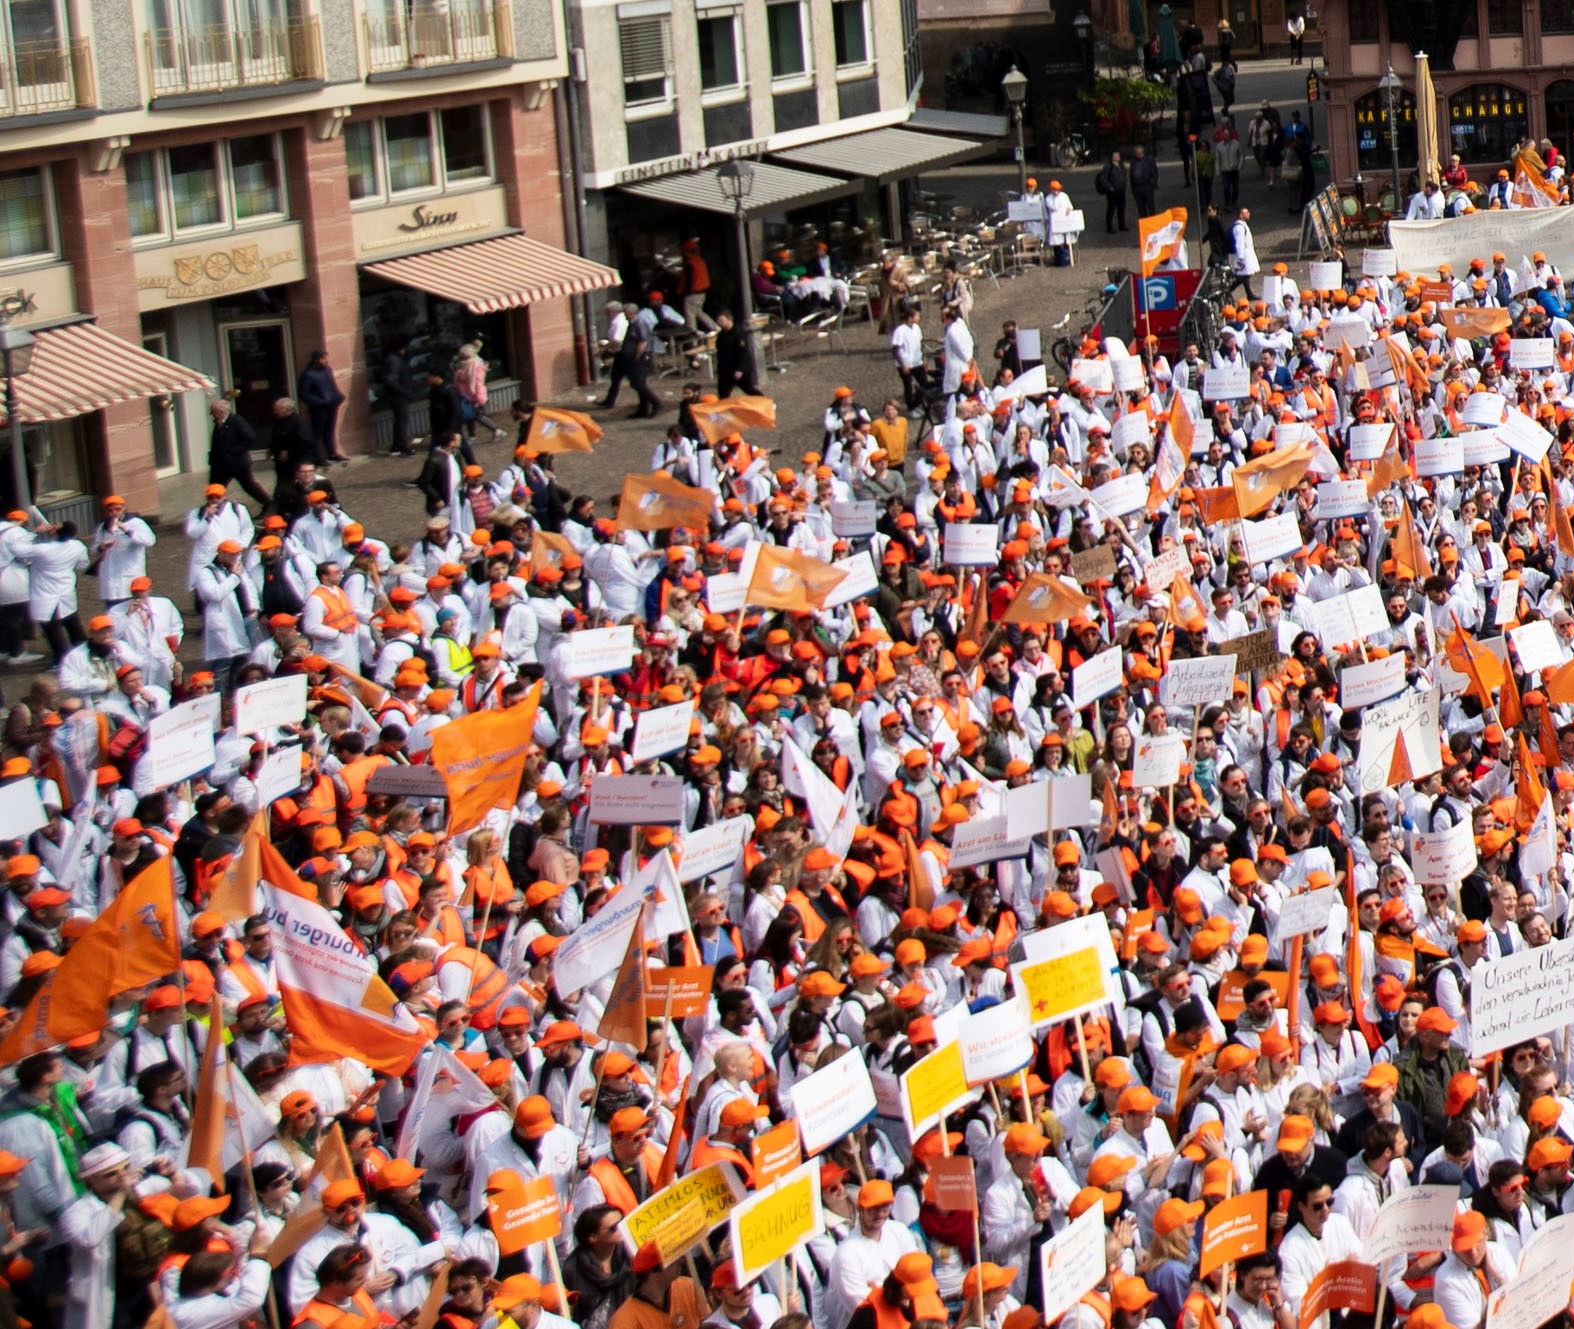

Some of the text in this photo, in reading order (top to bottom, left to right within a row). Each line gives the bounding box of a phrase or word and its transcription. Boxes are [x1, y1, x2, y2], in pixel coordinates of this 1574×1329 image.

[1453, 103, 1524, 117] CHANGE
[621, 140, 769, 183] EINSTEIN KAFFEE
[397, 204, 458, 232] Sinn
[1148, 285, 1167, 307] P
[1235, 631, 1267, 648] STOP
